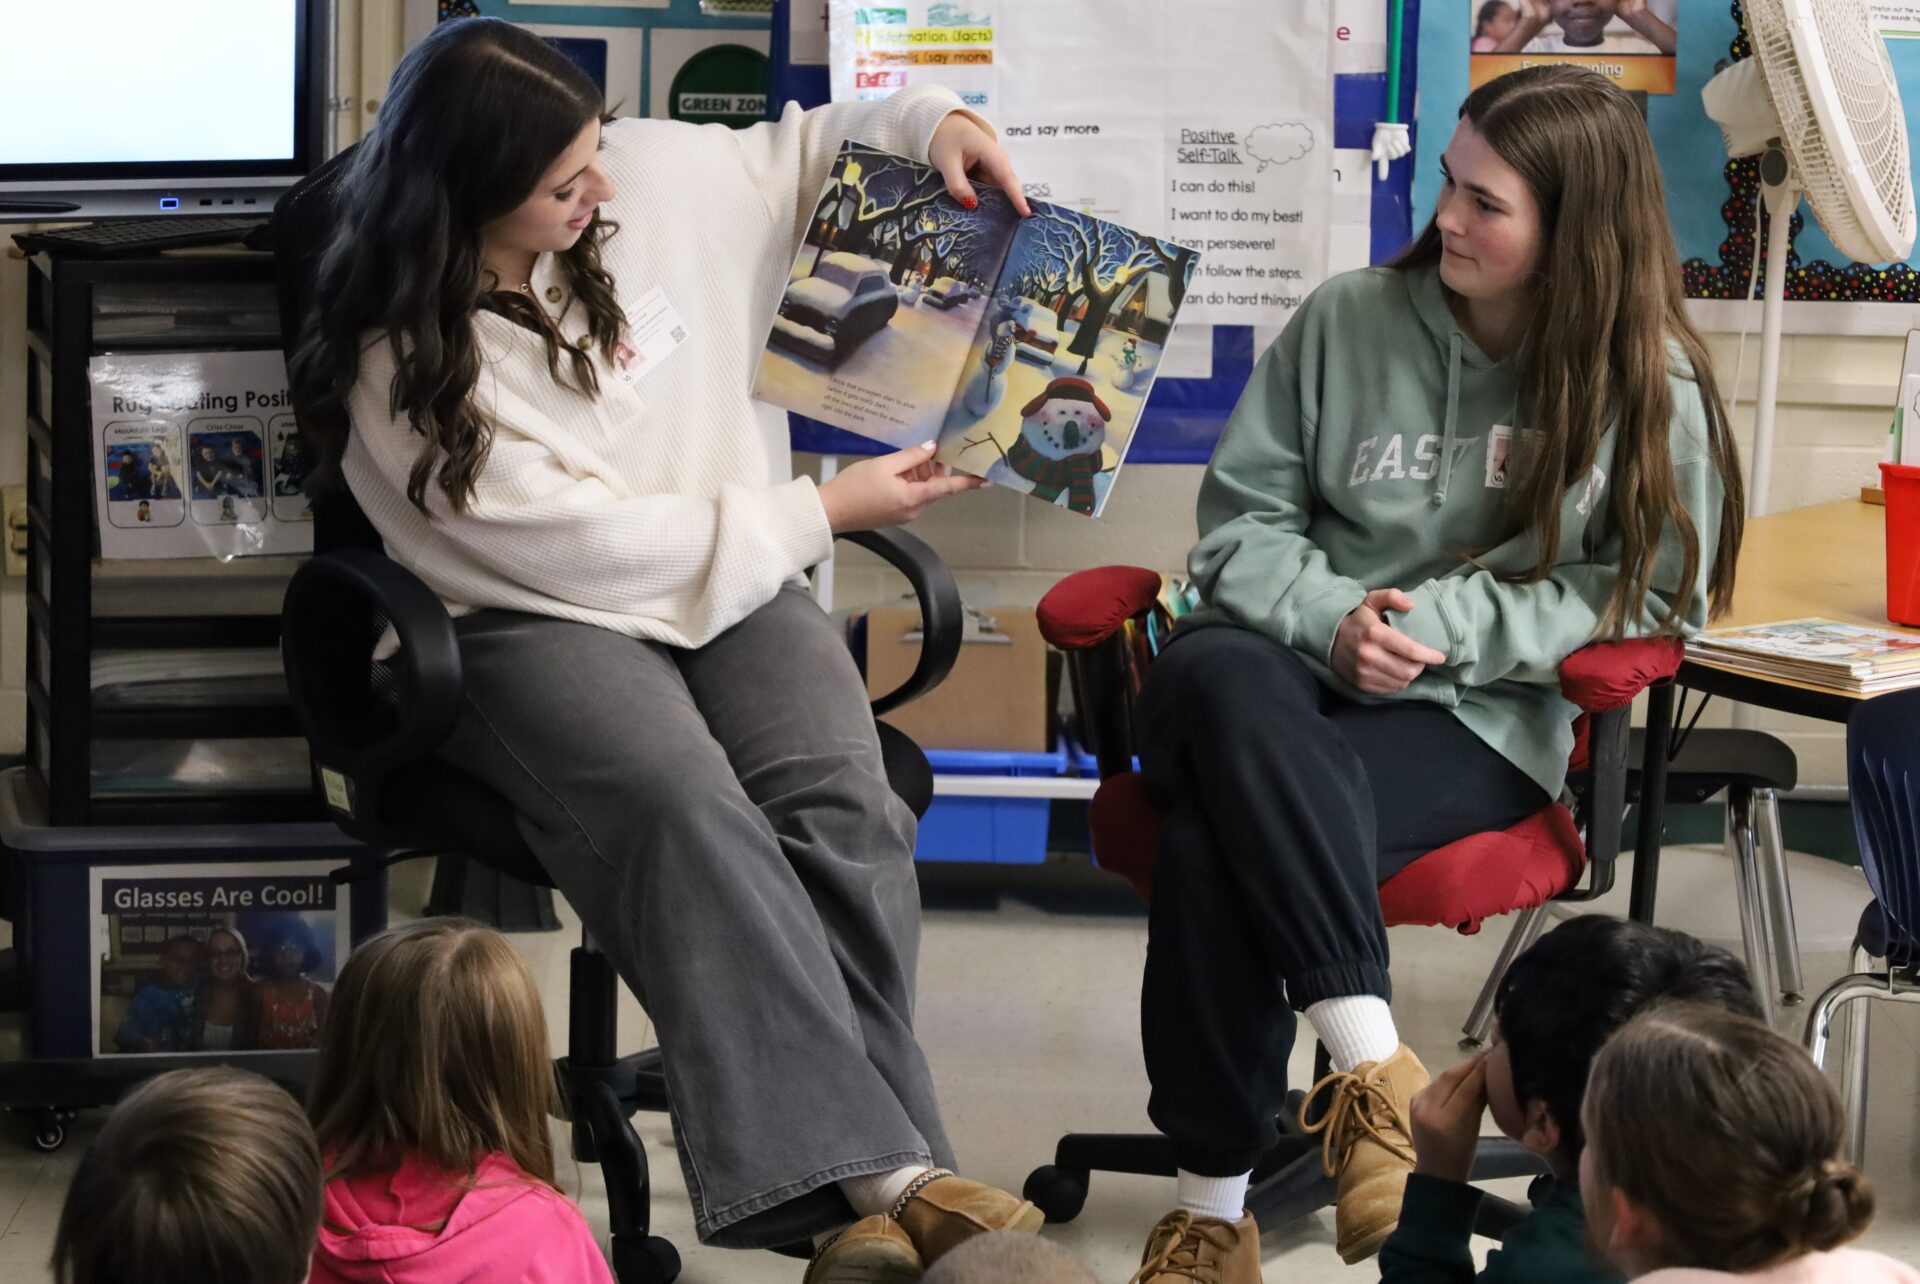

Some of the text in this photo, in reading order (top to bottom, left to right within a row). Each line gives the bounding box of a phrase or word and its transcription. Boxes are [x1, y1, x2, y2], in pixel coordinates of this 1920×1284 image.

[953, 29, 993, 42] (facts)
[682, 97, 732, 112] GREEN
[1006, 124, 1100, 139] and say more
[1181, 128, 1237, 144] Positive
[1177, 148, 1242, 164] Self-Talk
[1171, 179, 1256, 194] I can do this!
[1171, 208, 1303, 225] I want to do my best!
[1207, 238, 1275, 253] persevere!
[1206, 265, 1243, 279] follow
[1246, 266, 1266, 279] the
[1268, 266, 1303, 282] steps.
[1184, 294, 1203, 305] an
[1206, 291, 1225, 305] do
[1227, 293, 1258, 306] hard
[114, 884, 324, 910] Glasses Are Cool!
